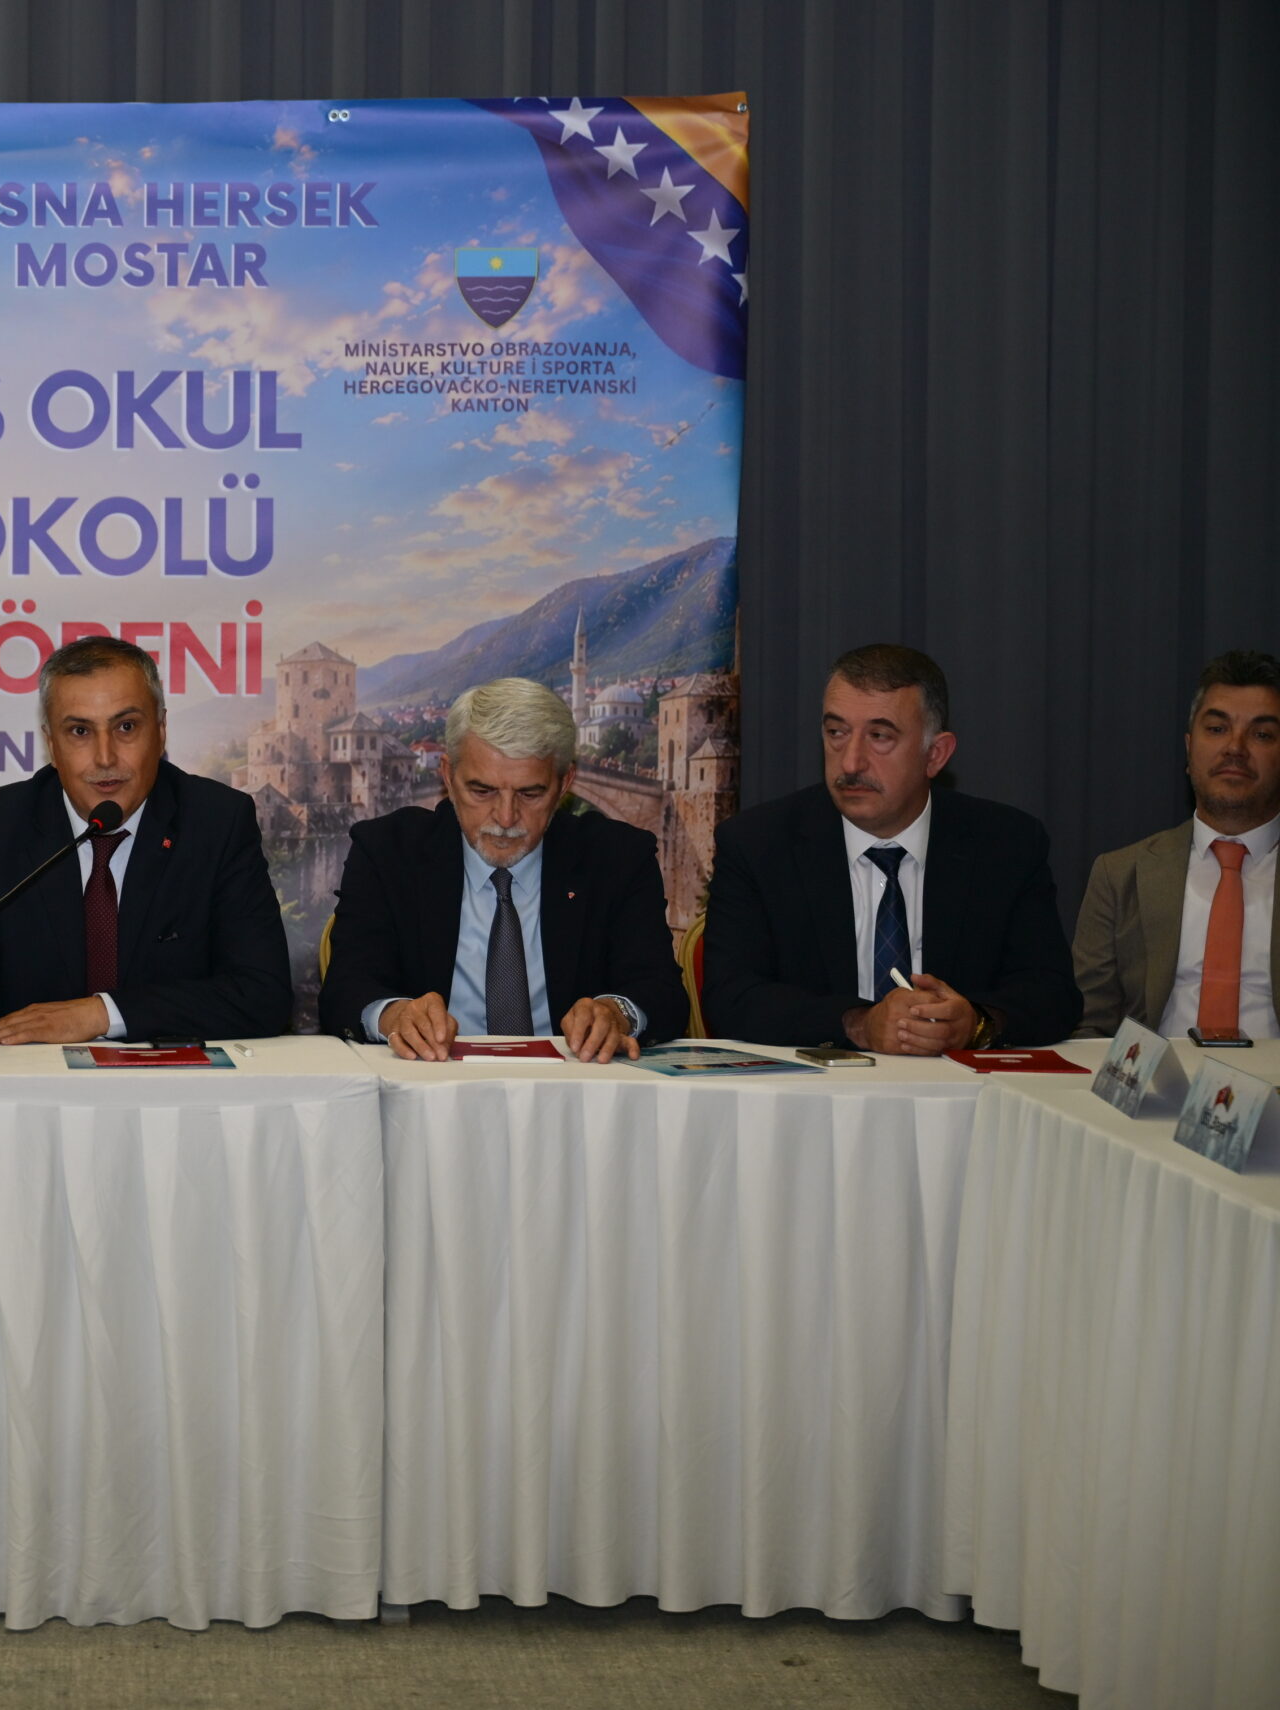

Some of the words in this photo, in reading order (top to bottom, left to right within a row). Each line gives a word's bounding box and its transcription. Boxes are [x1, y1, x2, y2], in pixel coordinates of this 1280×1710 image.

[142, 181, 379, 228] HERSEK
[16, 241, 268, 288] MOSTAR
[344, 339, 484, 357] MİNİSTARSTVO
[491, 342, 637, 360] OBRAZOVANJA,
[365, 361, 434, 378] NAUKE,
[440, 361, 525, 376] KULTURE
[542, 360, 615, 376] SPORTA
[31, 368, 303, 451] OKUL
[451, 398, 529, 413] KANTON
